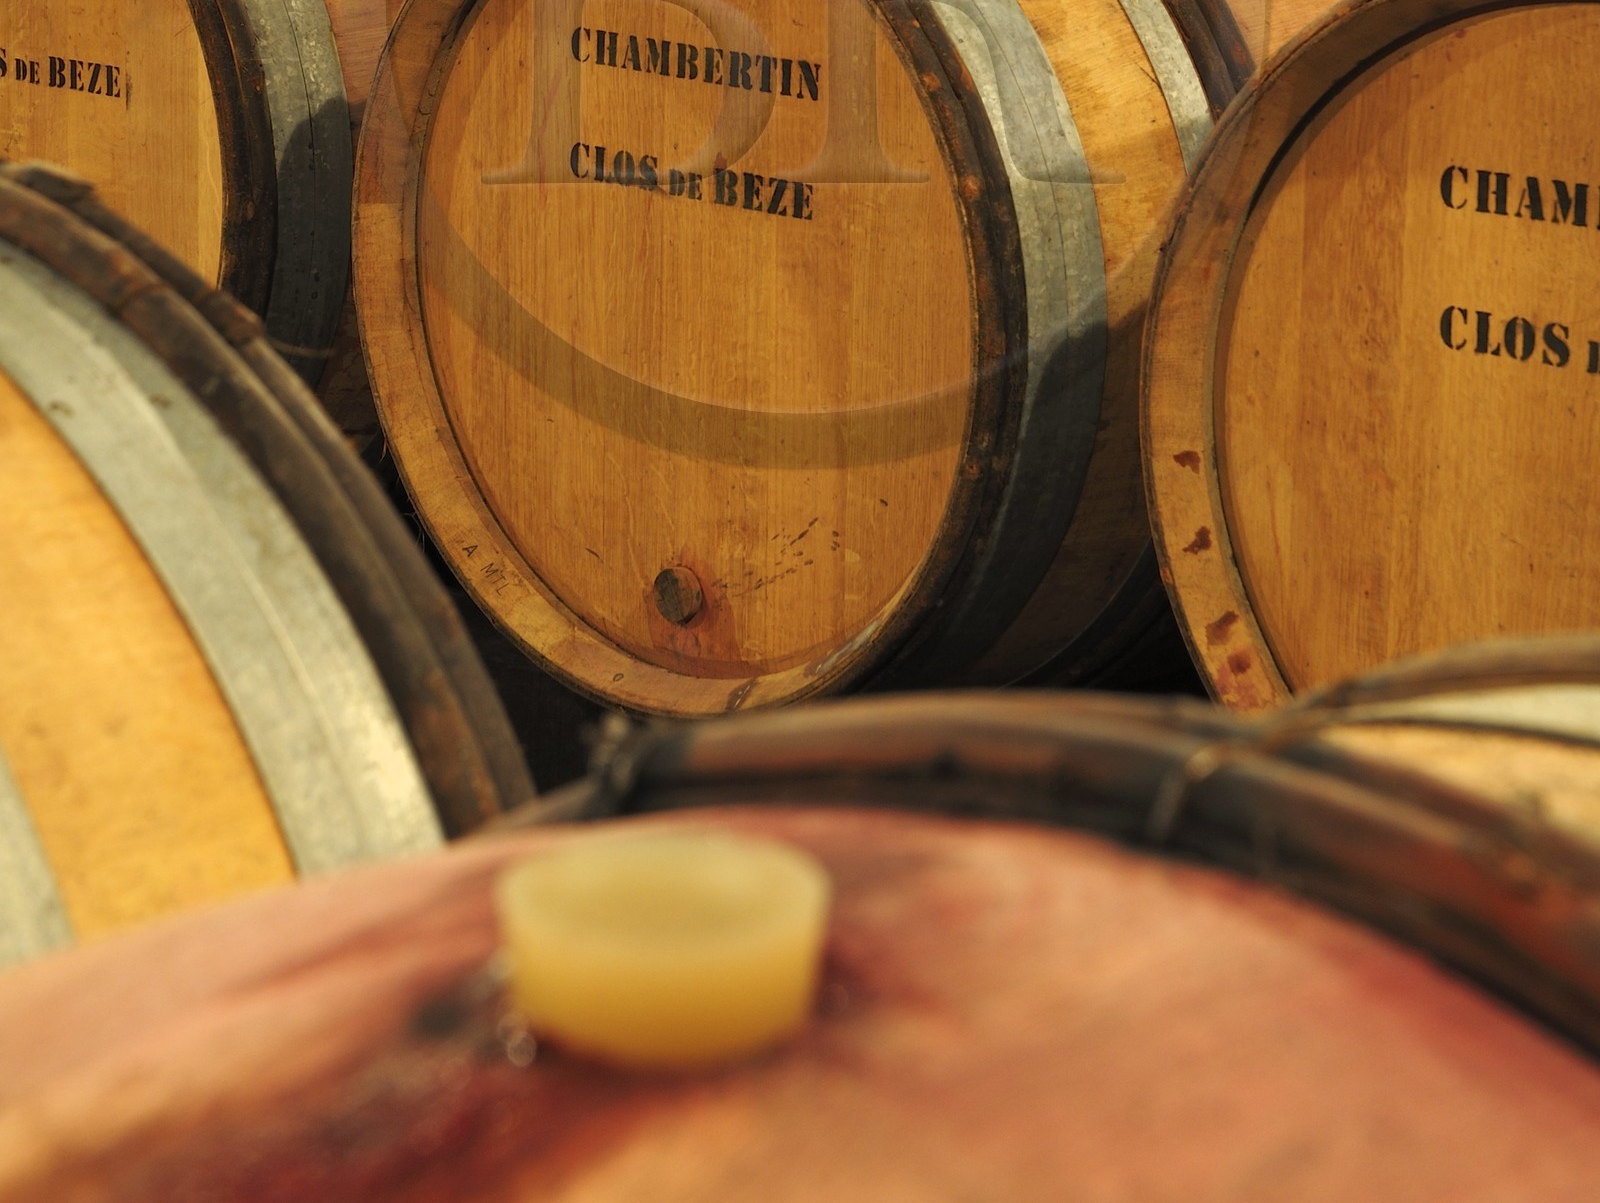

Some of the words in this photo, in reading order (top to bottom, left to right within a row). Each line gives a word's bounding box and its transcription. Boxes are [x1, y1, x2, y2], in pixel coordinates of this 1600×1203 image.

[15, 57, 41, 86] DE
[48, 55, 121, 98] BEZE
[570, 26, 822, 102] CHAMBERTIN
[569, 141, 659, 192] CLOS
[668, 167, 703, 201] DE
[712, 166, 814, 221] BEZE
[1440, 164, 1600, 231] CHAM
[1439, 304, 1571, 368] CLOS
